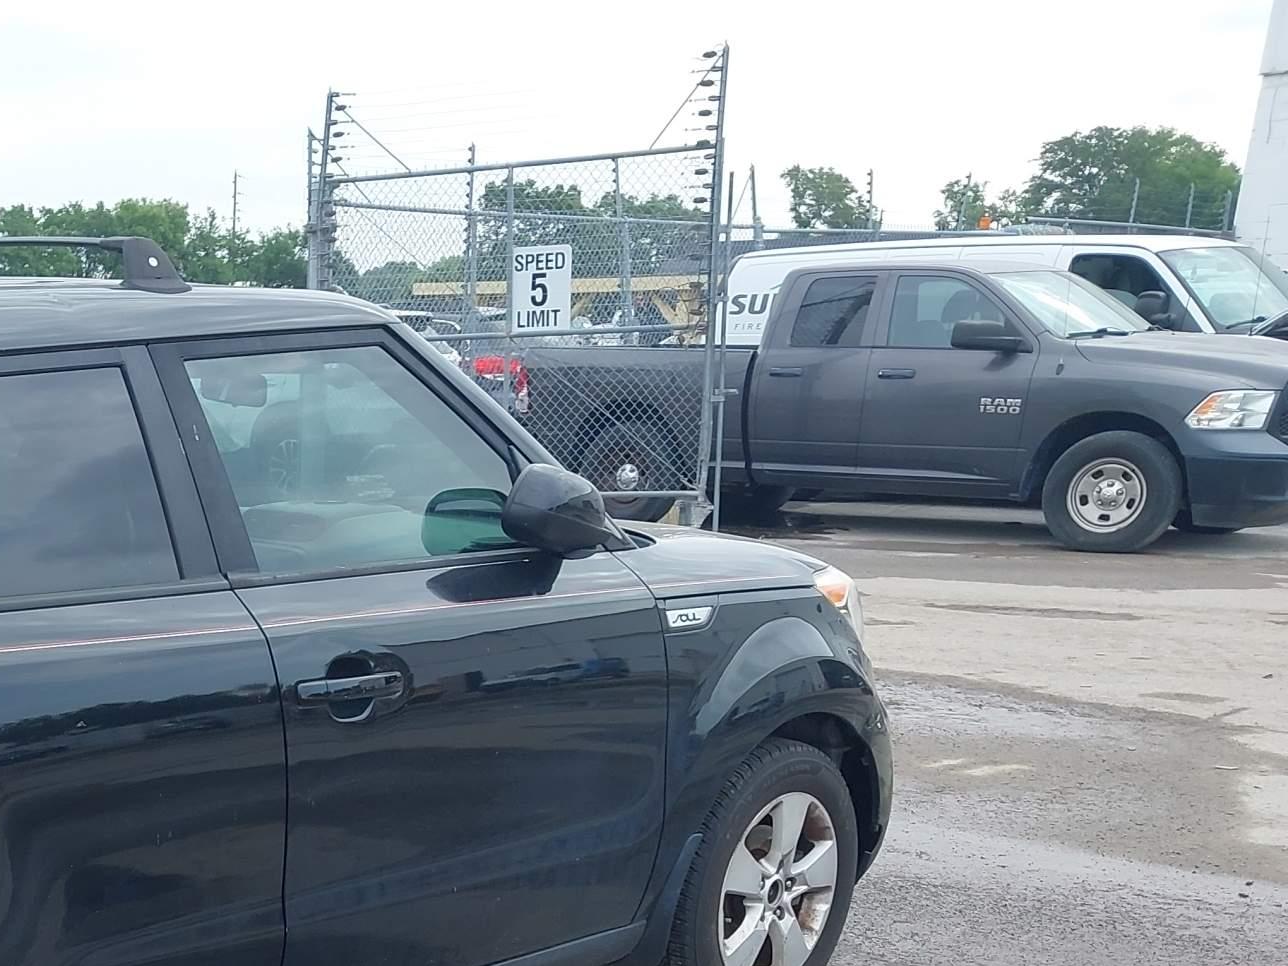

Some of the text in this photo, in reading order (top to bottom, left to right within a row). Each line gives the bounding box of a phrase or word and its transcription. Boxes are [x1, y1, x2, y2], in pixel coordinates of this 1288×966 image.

[514, 251, 566, 272] SPEED
[530, 272, 549, 307] 5
[728, 293, 778, 315] SU
[517, 309, 561, 328] LIMIT
[979, 405, 1021, 414] 1500
[980, 397, 1022, 406] RAM
